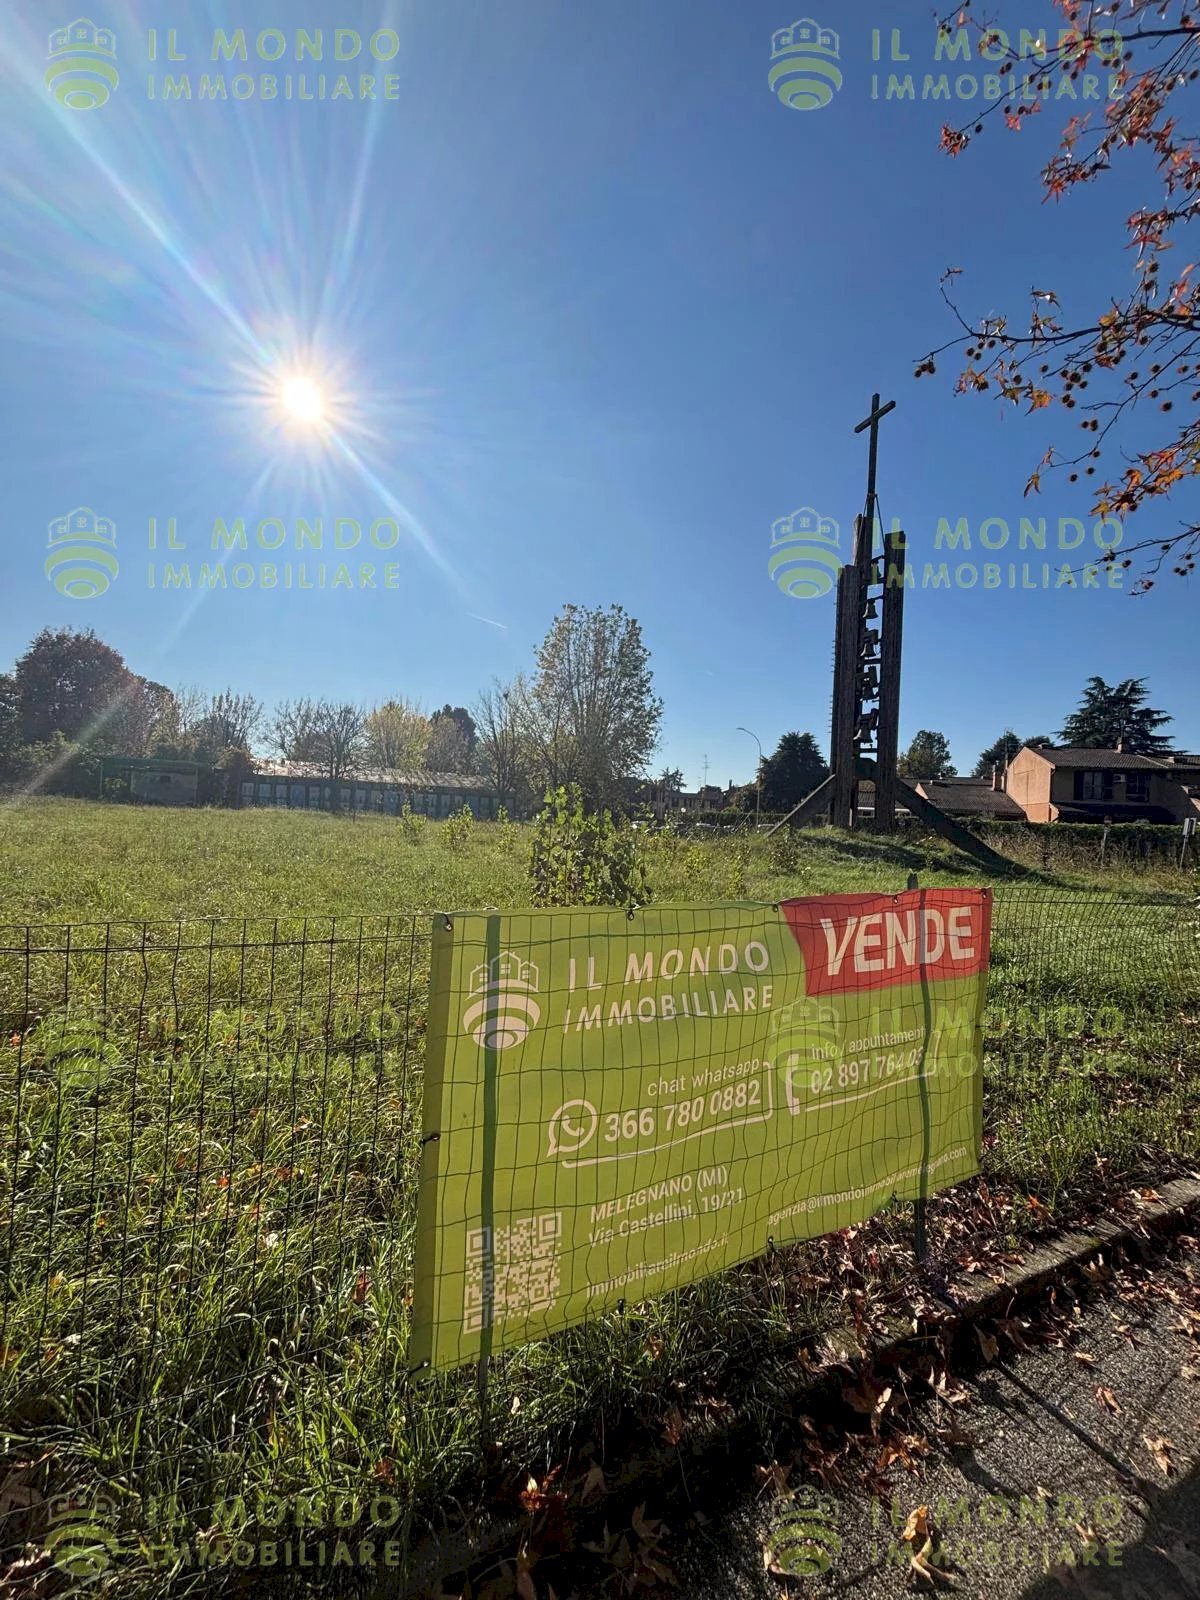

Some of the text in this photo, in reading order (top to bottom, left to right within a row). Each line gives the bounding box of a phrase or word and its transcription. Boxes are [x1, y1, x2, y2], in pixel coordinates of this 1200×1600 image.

[568, 941, 769, 992] IL MONDO
[819, 906, 975, 976] VENDE
[564, 985, 773, 1033] IMMOBILIARE
[812, 1041, 838, 1060] info
[647, 1057, 759, 1096] chat whatsapp
[811, 1067, 833, 1094] 02
[838, 1059, 871, 1087] 897
[604, 1079, 761, 1142] 366 780 0882
[588, 1187, 744, 1247] Via Castellini, 19/21
[590, 1166, 728, 1224] MELEGNANO (MI)
